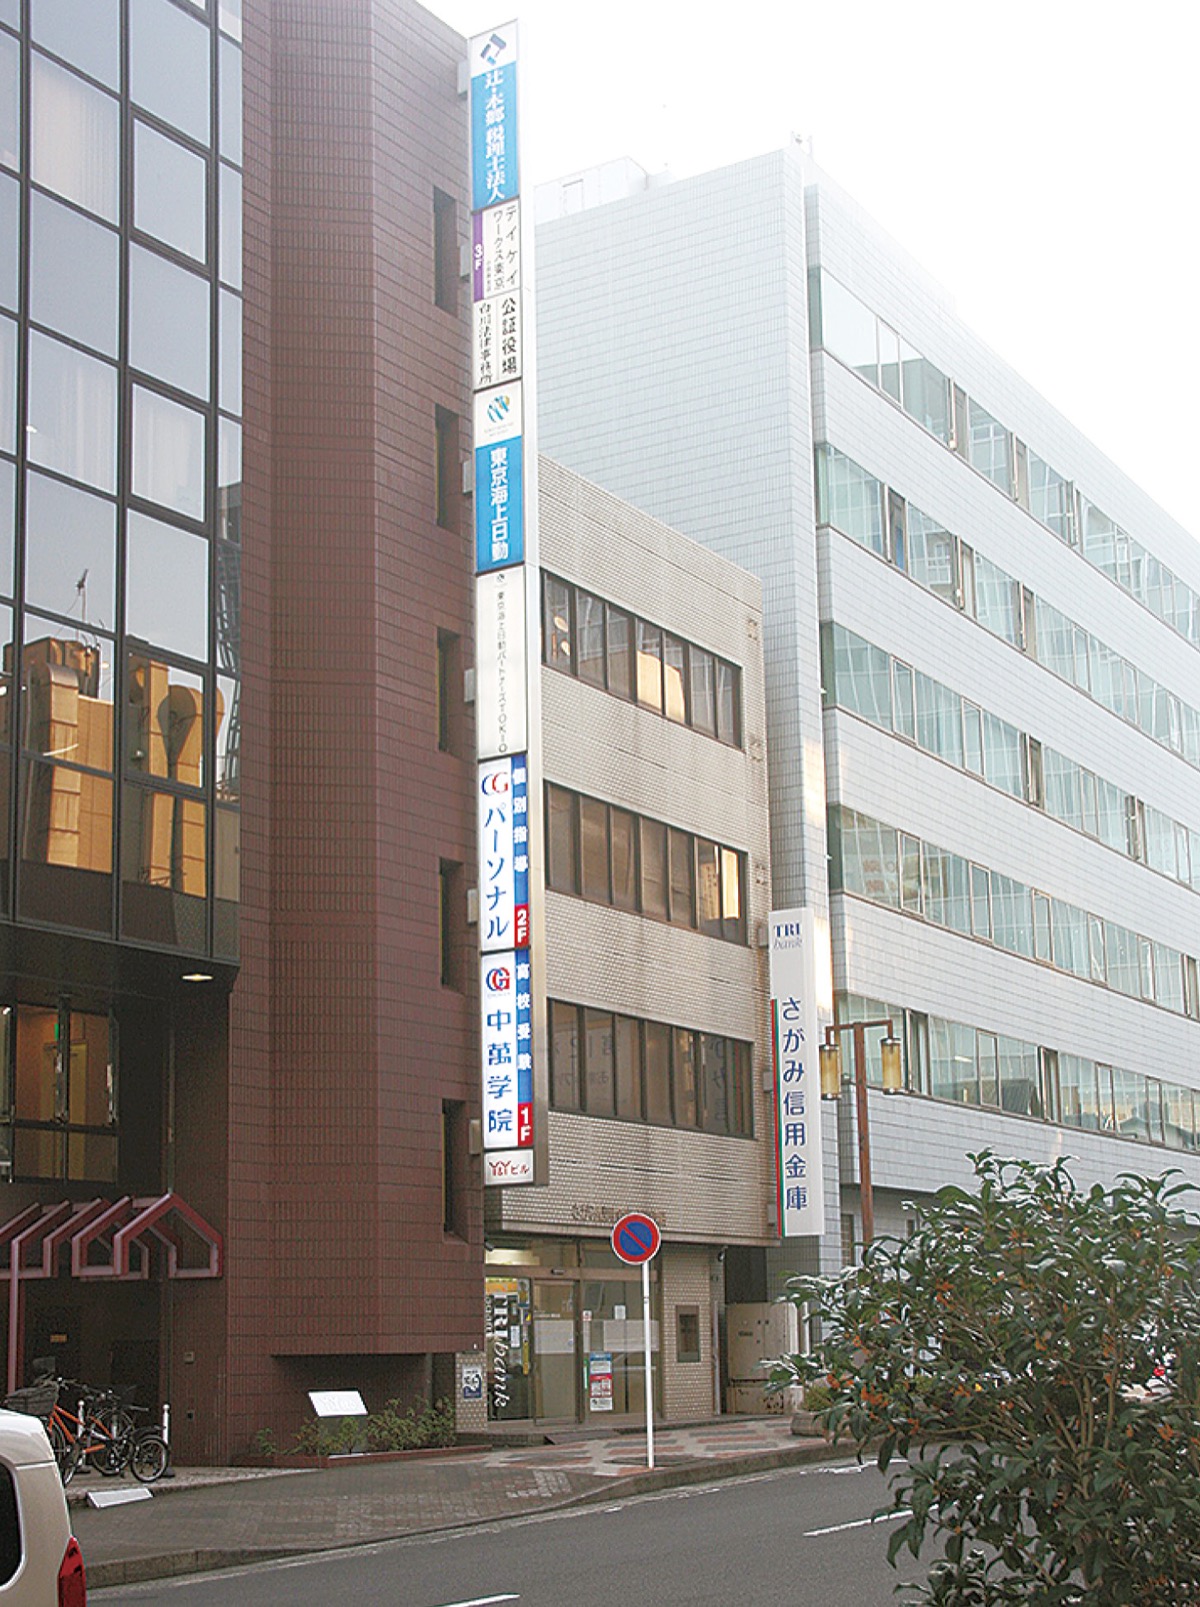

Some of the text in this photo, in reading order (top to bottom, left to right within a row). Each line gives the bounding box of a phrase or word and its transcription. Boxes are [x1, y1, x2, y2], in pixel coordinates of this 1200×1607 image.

[474, 243, 483, 271] 3F
[490, 447, 509, 562] 東京海上日動
[484, 801, 509, 939] パーソナル
[517, 909, 527, 943] 2F
[773, 922, 801, 937] TRI
[773, 935, 803, 950] bank
[487, 1009, 512, 1133] 中萬学院
[782, 996, 807, 1212] さがみ信用金庫
[520, 1107, 530, 1141] 1F
